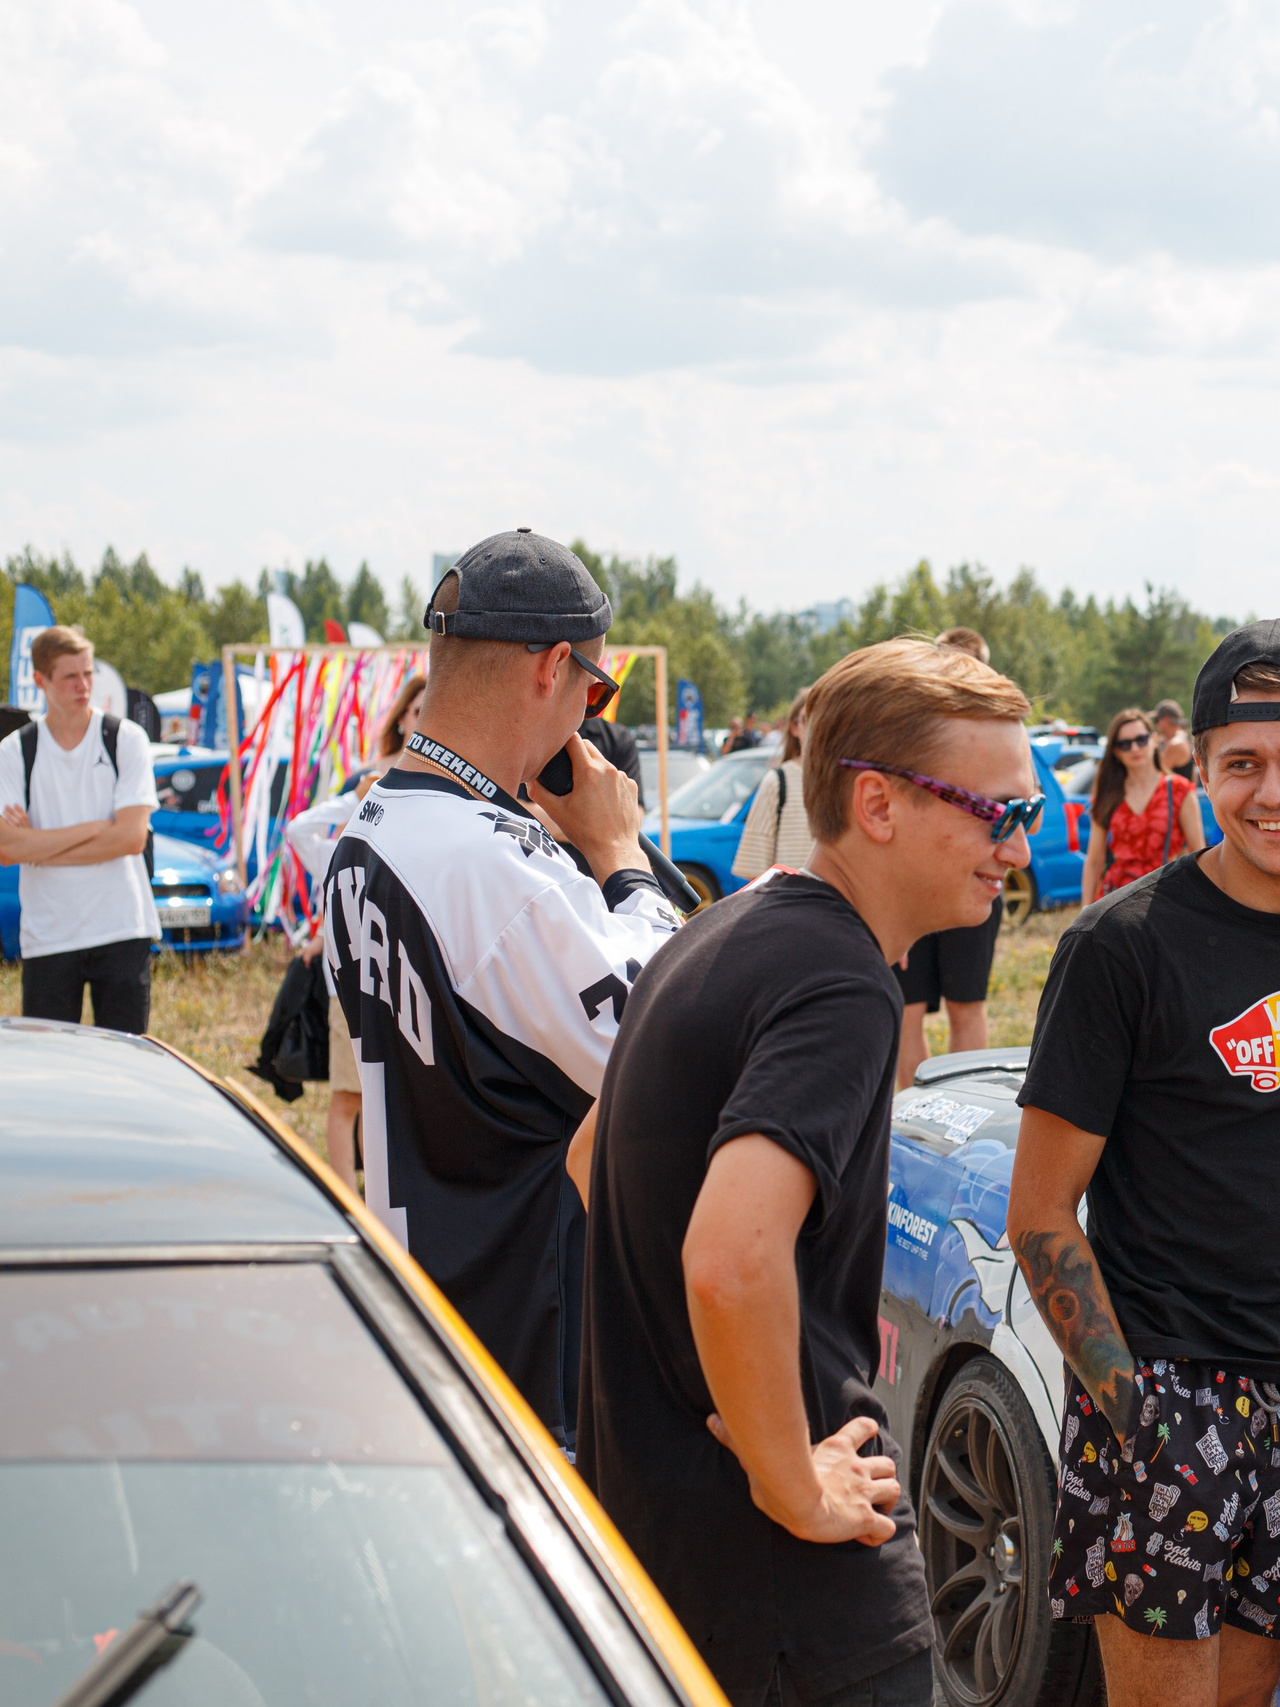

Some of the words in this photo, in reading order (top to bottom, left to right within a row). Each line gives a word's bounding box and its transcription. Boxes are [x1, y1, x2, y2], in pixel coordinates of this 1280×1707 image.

[420, 739, 498, 798] WEEKEND
[1226, 1034, 1274, 1064] "OFF
[1164, 1540, 1191, 1557] Bad
[1164, 1552, 1202, 1571] Habits
